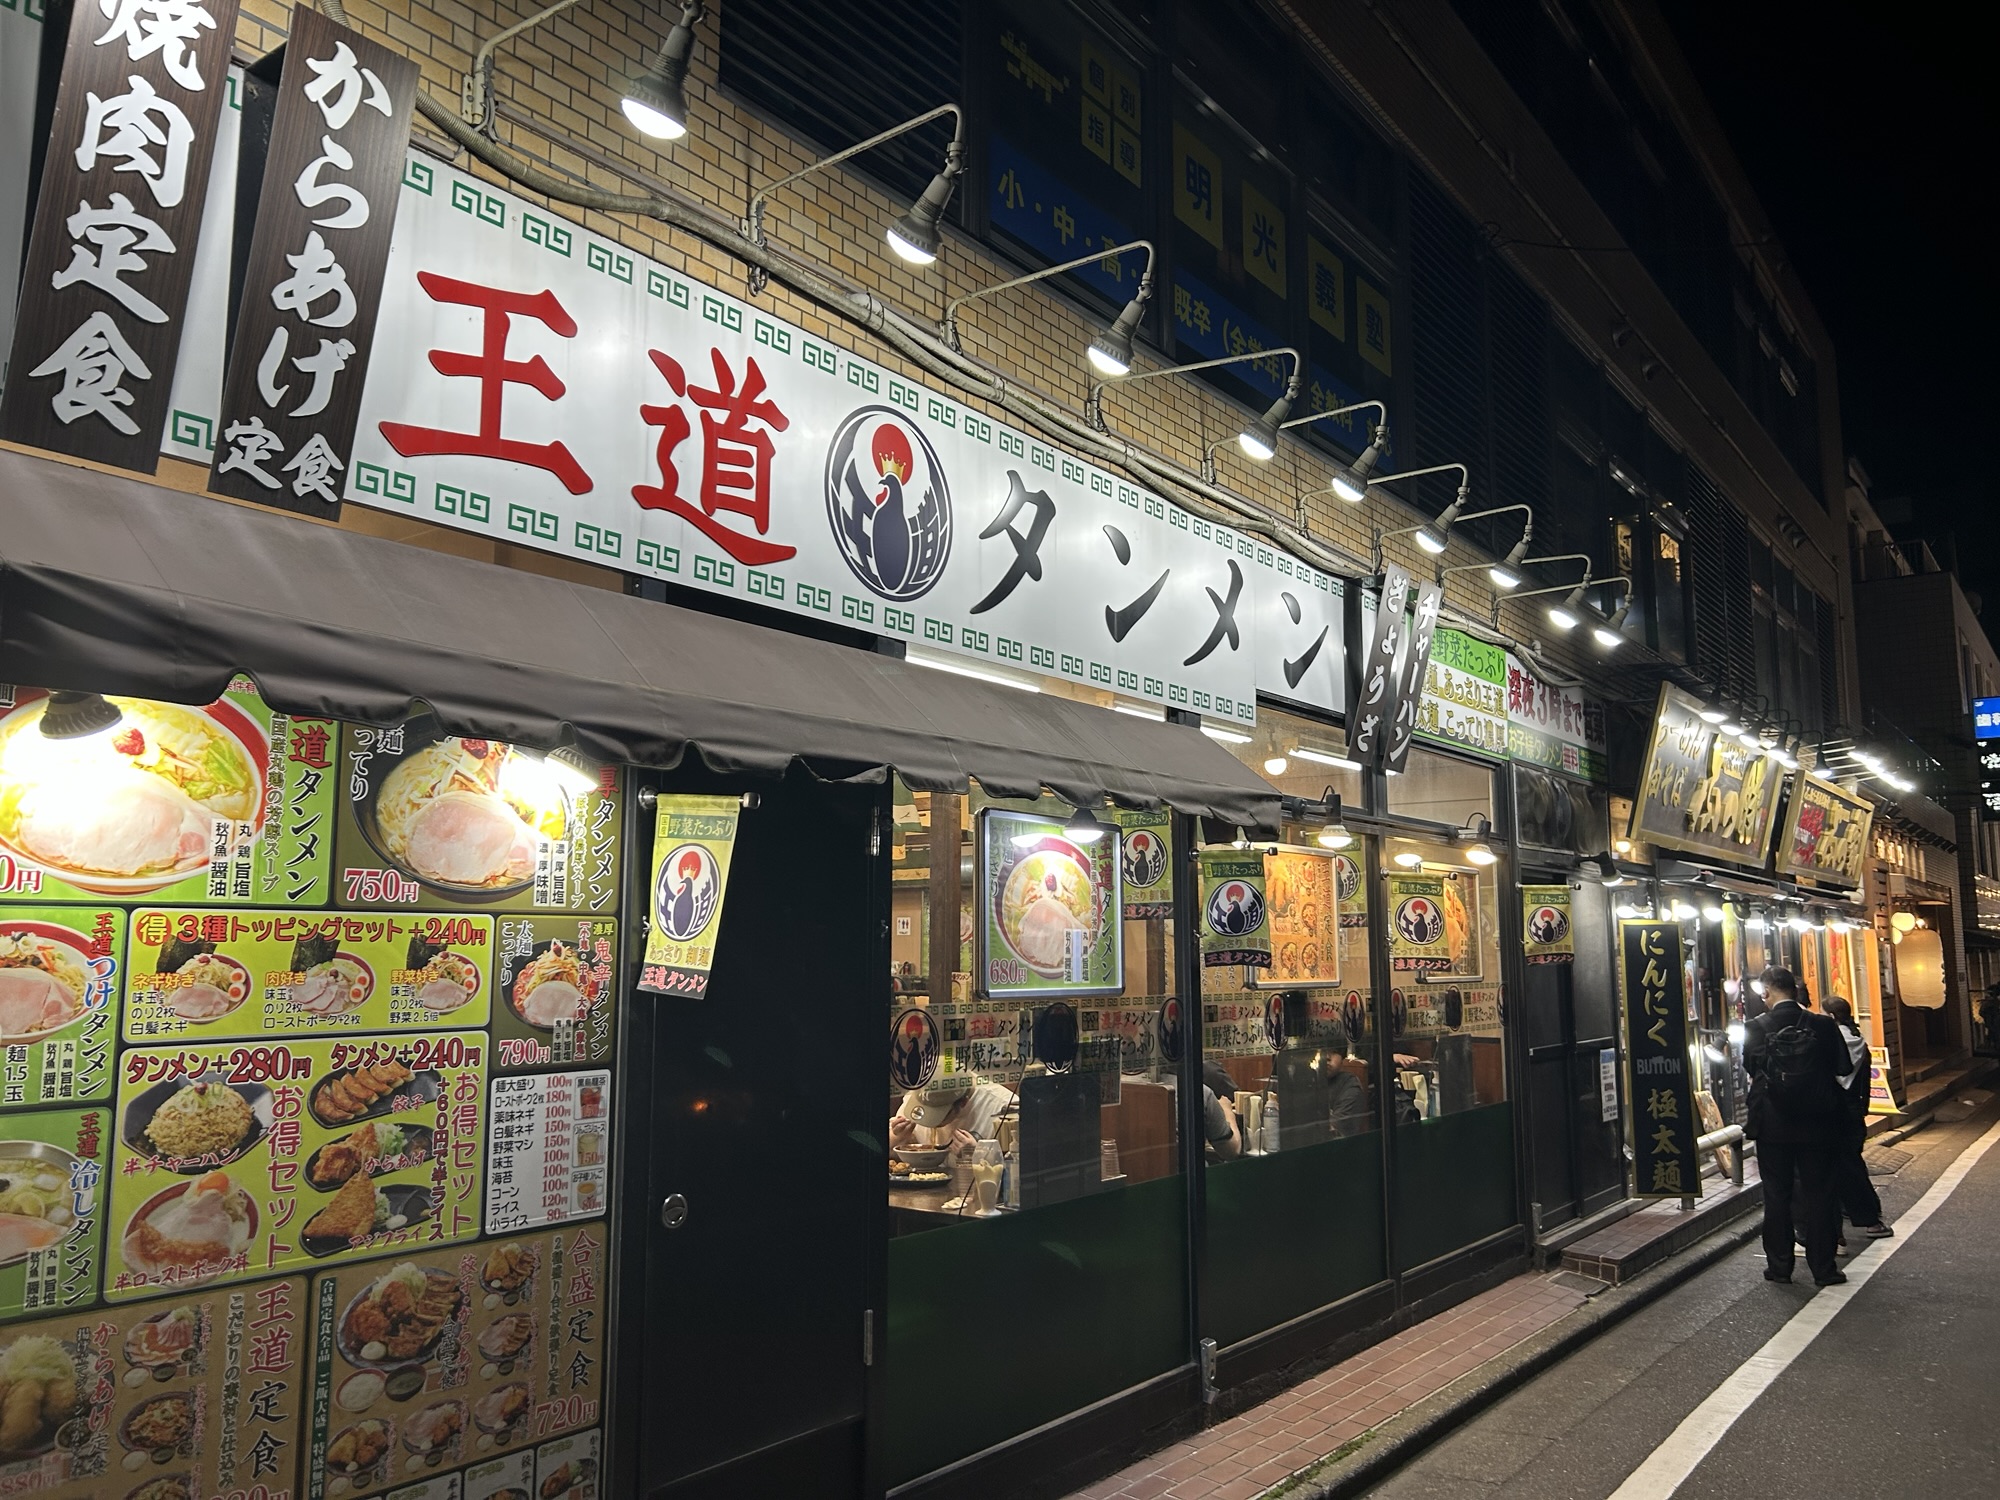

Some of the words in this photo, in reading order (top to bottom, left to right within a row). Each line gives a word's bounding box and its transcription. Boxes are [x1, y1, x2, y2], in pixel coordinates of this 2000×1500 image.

[379, 270, 797, 566] 王道
[970, 470, 1329, 690] タンメン
[1390, 593, 1436, 763] チャーハン
[284, 715, 332, 902] 道タンメン
[669, 817, 735, 837] 野菜たっぷり
[344, 868, 420, 902] 750円
[140, 915, 168, 944] 得
[177, 914, 403, 943] 3種トッピングセット
[408, 917, 487, 946] +240円
[500, 922, 516, 987] こってり
[133, 973, 196, 989] ネギ好き
[265, 972, 307, 986] 肉好き
[390, 970, 439, 983] 野菜好き
[640, 965, 709, 993] 王道タンメン
[989, 958, 1027, 985] 680円
[1640, 929, 1668, 1047] にんにく
[77, 912, 118, 1098] 王道つけタンメン
[131, 1007, 176, 1019] のり2枚
[264, 1003, 303, 1014] のり2枚
[389, 1012, 439, 1024] 野菜2.5倍
[390, 999, 424, 1010] のり2枚
[130, 1020, 188, 1035] 白髪ネギ
[127, 1047, 312, 1084] タンメン+280円
[331, 1037, 482, 1070] タンメン+240円
[499, 1038, 551, 1067] 790円
[495, 1078, 536, 1093] 麺大盛り
[494, 1108, 535, 1124] 薬味ネギ
[494, 1123, 534, 1139] 白髪ネギ
[1647, 1088, 1682, 1192] 極太麺
[451, 1072, 480, 1237] お得セット
[493, 1139, 534, 1155] 野菜マシ
[122, 1148, 240, 1176] 半チャーハン
[364, 1150, 426, 1173] からあげ
[492, 1156, 514, 1169] 味玉
[267, 1085, 304, 1268] お得セット
[491, 1171, 513, 1185] 海苔
[491, 1186, 520, 1200] コーン
[62, 1112, 102, 1306] 王道冷しタンメン
[491, 1200, 520, 1216] ライス
[490, 1214, 529, 1231] 小ライス
[348, 1226, 423, 1251] アジフライ
[114, 1253, 249, 1290] 半ローストポーク丼
[241, 1283, 296, 1481] 王道定食
[534, 1394, 598, 1437] 720円
